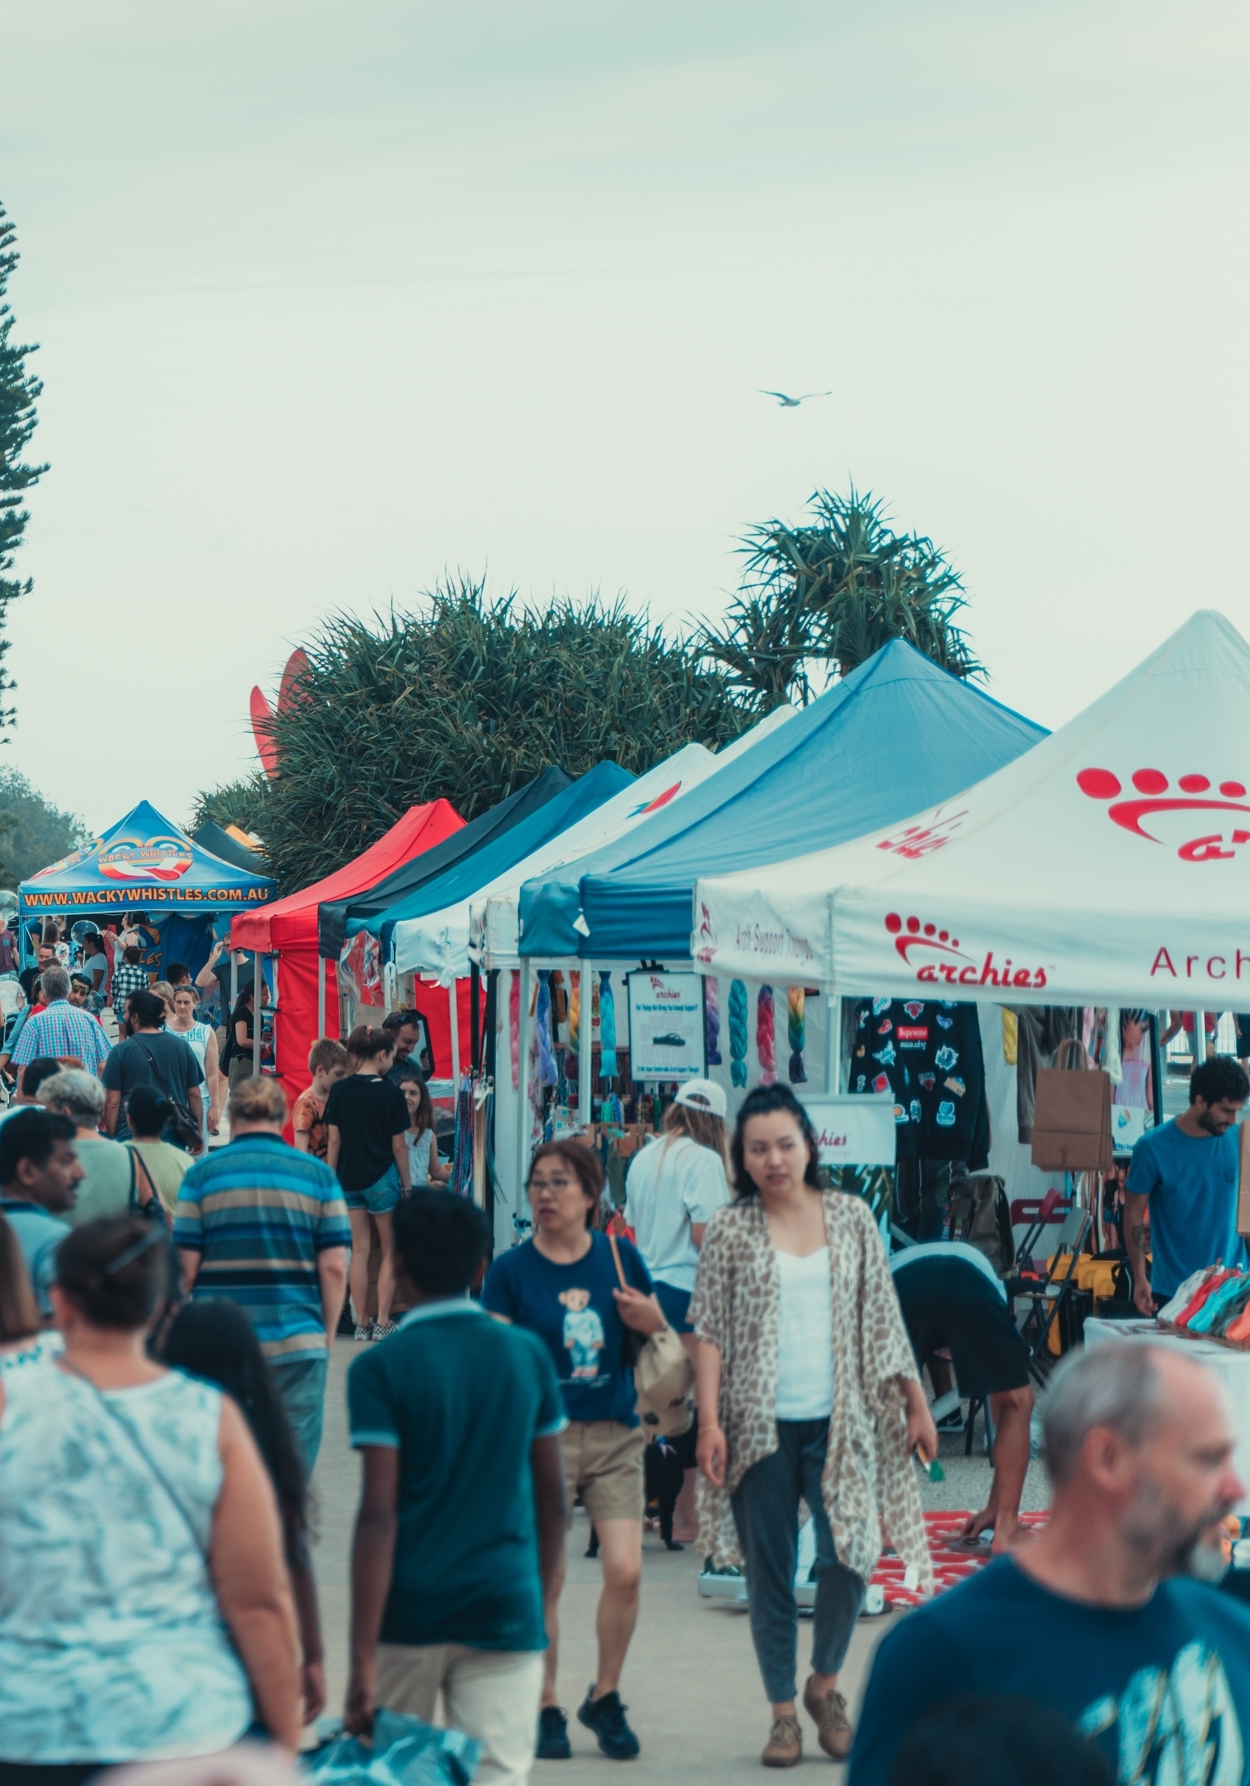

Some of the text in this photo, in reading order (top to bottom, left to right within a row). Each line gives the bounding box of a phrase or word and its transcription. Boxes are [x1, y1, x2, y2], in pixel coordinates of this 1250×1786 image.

[24, 886, 269, 908] WWW.WACKYWHISTLES.COM.AU
[753, 922, 784, 959] Support
[916, 951, 1047, 988] archies
[898, 1027, 927, 1037] Supreme
